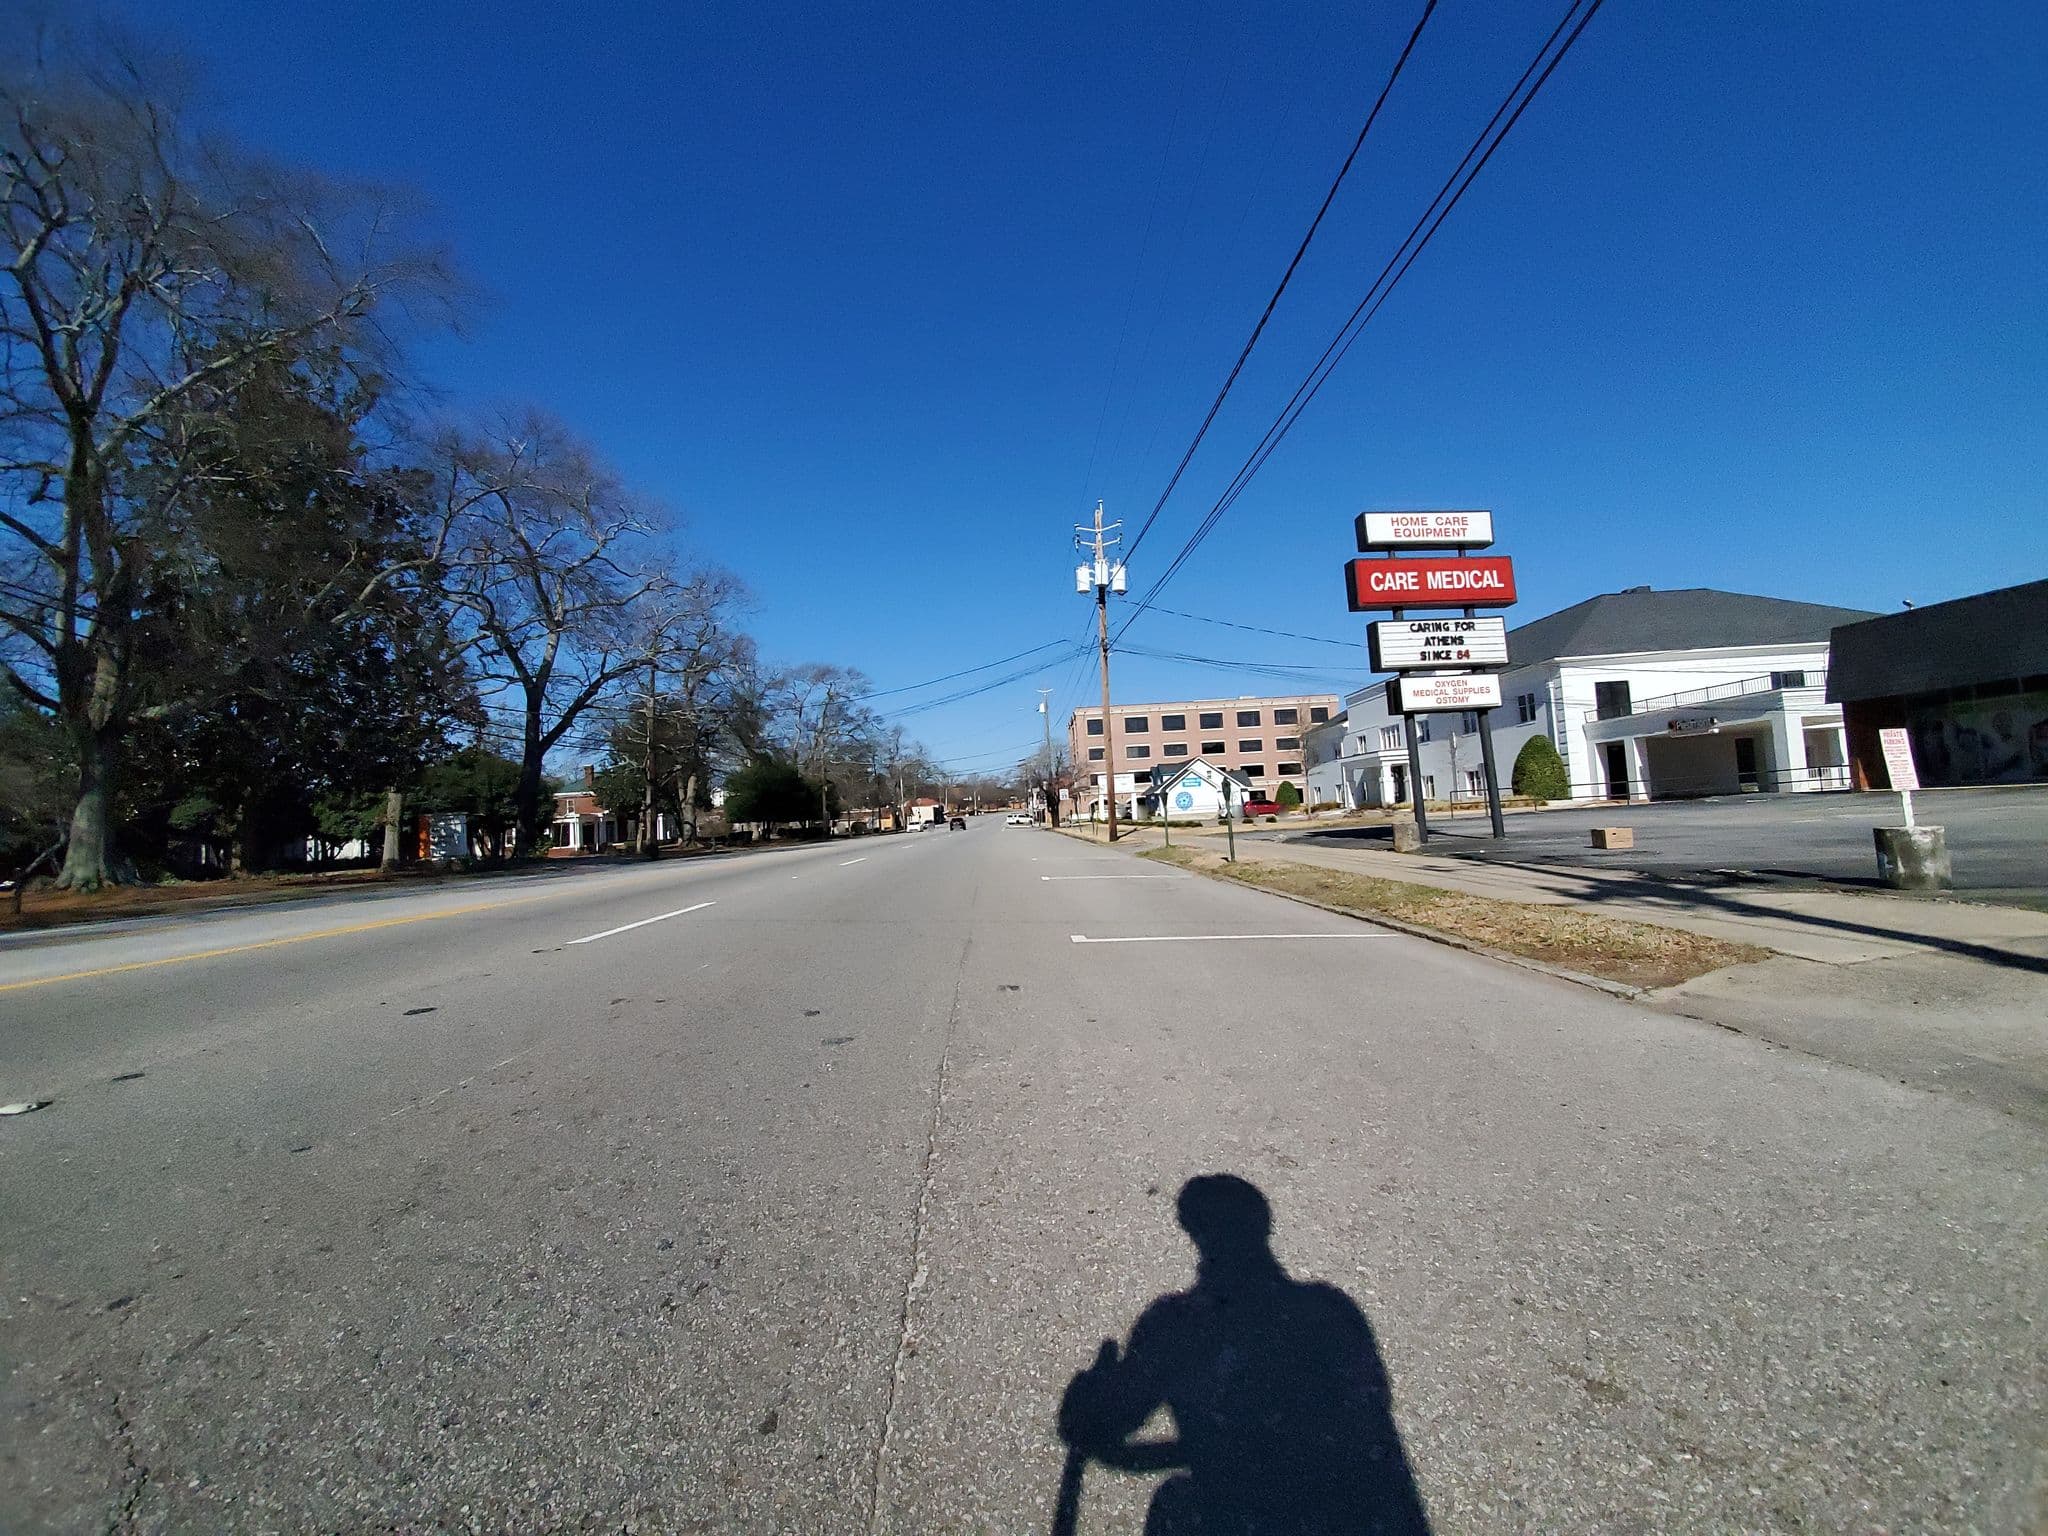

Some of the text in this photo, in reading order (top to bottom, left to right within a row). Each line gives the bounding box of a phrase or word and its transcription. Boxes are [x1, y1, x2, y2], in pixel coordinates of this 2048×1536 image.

[1391, 516, 1469, 527] HOME CARE
[1394, 527, 1468, 538] EQUIPMENT
[1370, 569, 1505, 592] CARE MEDICAL
[1409, 621, 1476, 633] CARING FOR
[1423, 635, 1465, 647] ATHENS
[1420, 650, 1452, 661] SINCE
[1434, 679, 1468, 688] OXYGEN
[1412, 686, 1491, 698] MEDICAL SUPPLIES
[1435, 695, 1470, 705] OSTOMY
